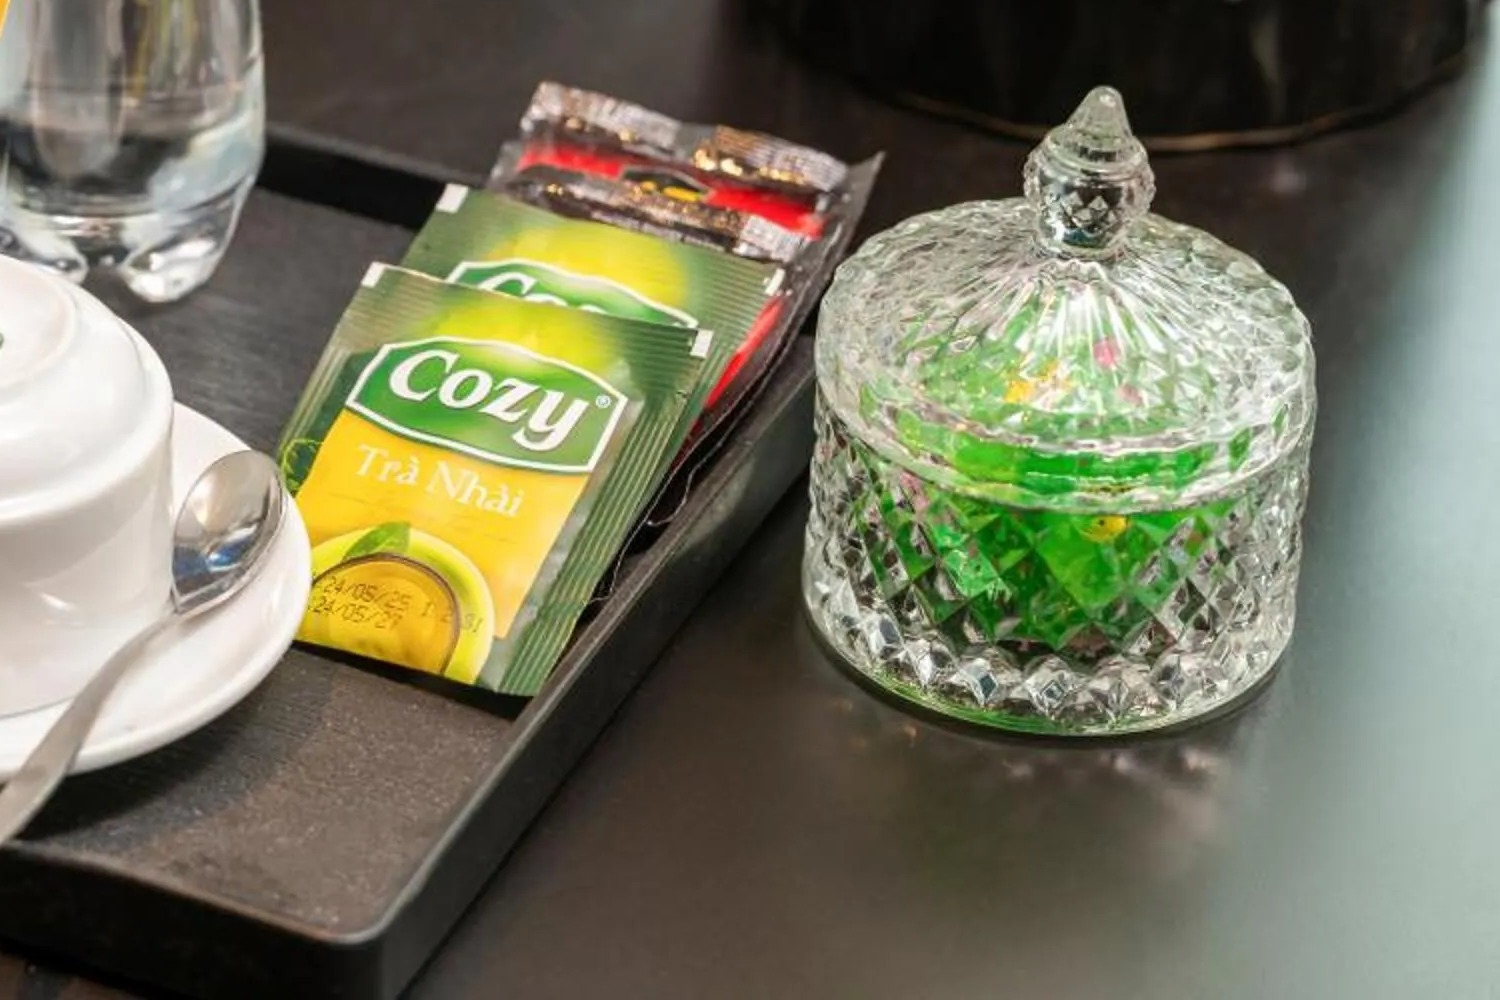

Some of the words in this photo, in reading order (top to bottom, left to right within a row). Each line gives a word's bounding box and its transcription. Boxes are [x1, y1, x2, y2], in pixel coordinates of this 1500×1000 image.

[389, 350, 589, 451] Cozy
[356, 443, 420, 486] Trà
[426, 460, 525, 518] Nhài
